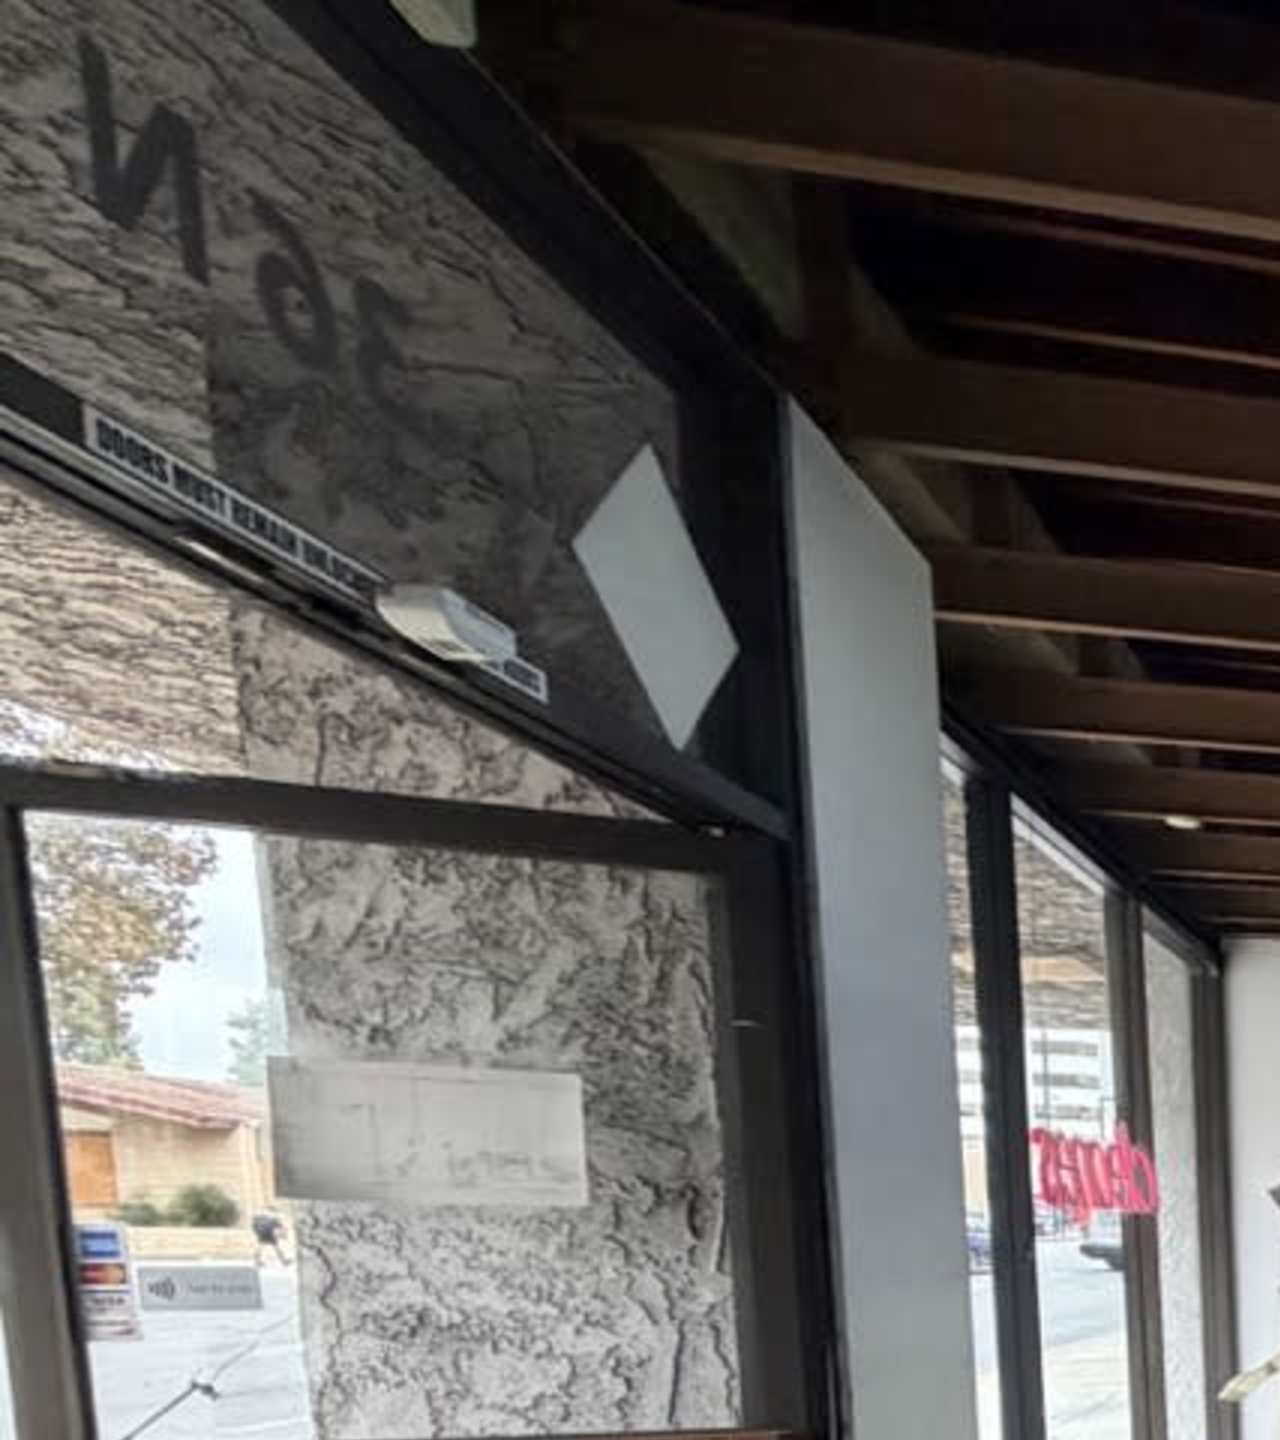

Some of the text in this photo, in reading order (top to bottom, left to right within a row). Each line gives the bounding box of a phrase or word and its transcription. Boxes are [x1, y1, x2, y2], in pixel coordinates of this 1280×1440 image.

[96, 416, 169, 486] DOORS
[171, 462, 227, 519] MUST
[230, 495, 298, 559] REMAIN
